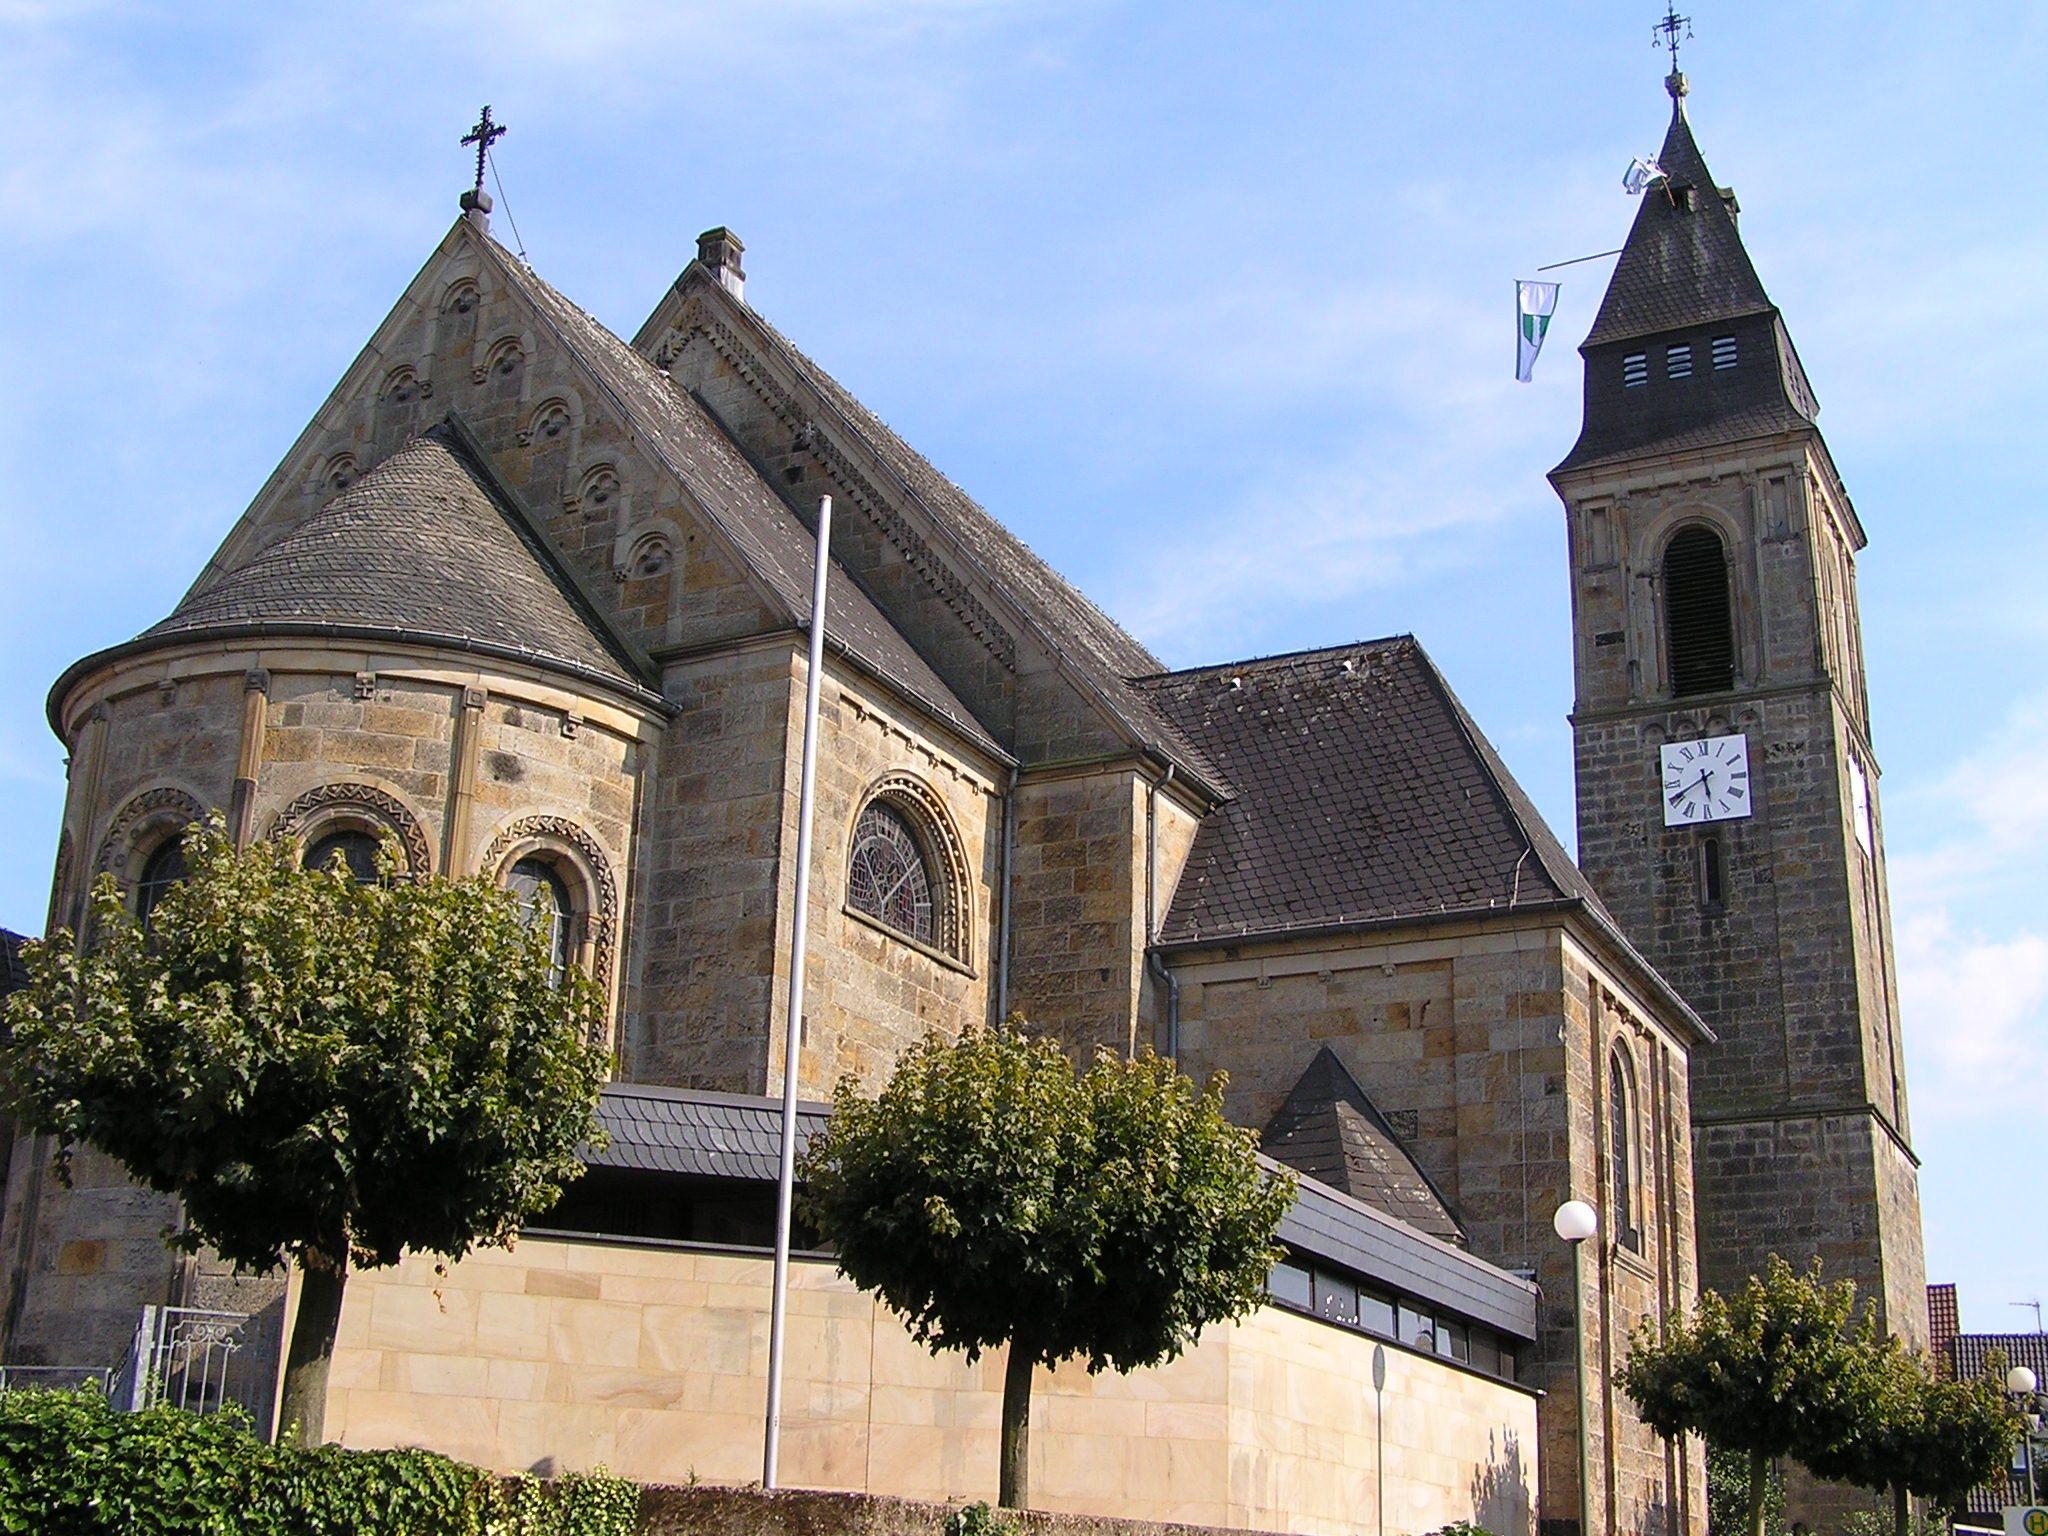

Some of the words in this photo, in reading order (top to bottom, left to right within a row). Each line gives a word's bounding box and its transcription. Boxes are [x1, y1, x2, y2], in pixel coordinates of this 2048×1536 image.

[1680, 747, 1694, 763] XI
[1697, 741, 1708, 757] XII
[1715, 742, 1725, 758] I
[1726, 753, 1741, 766] II
[1667, 761, 1684, 774] X
[1731, 771, 1747, 780] III
[1704, 804, 1713, 819] VI
[1718, 799, 1731, 813] V
[2030, 1515, 2045, 1531] H
